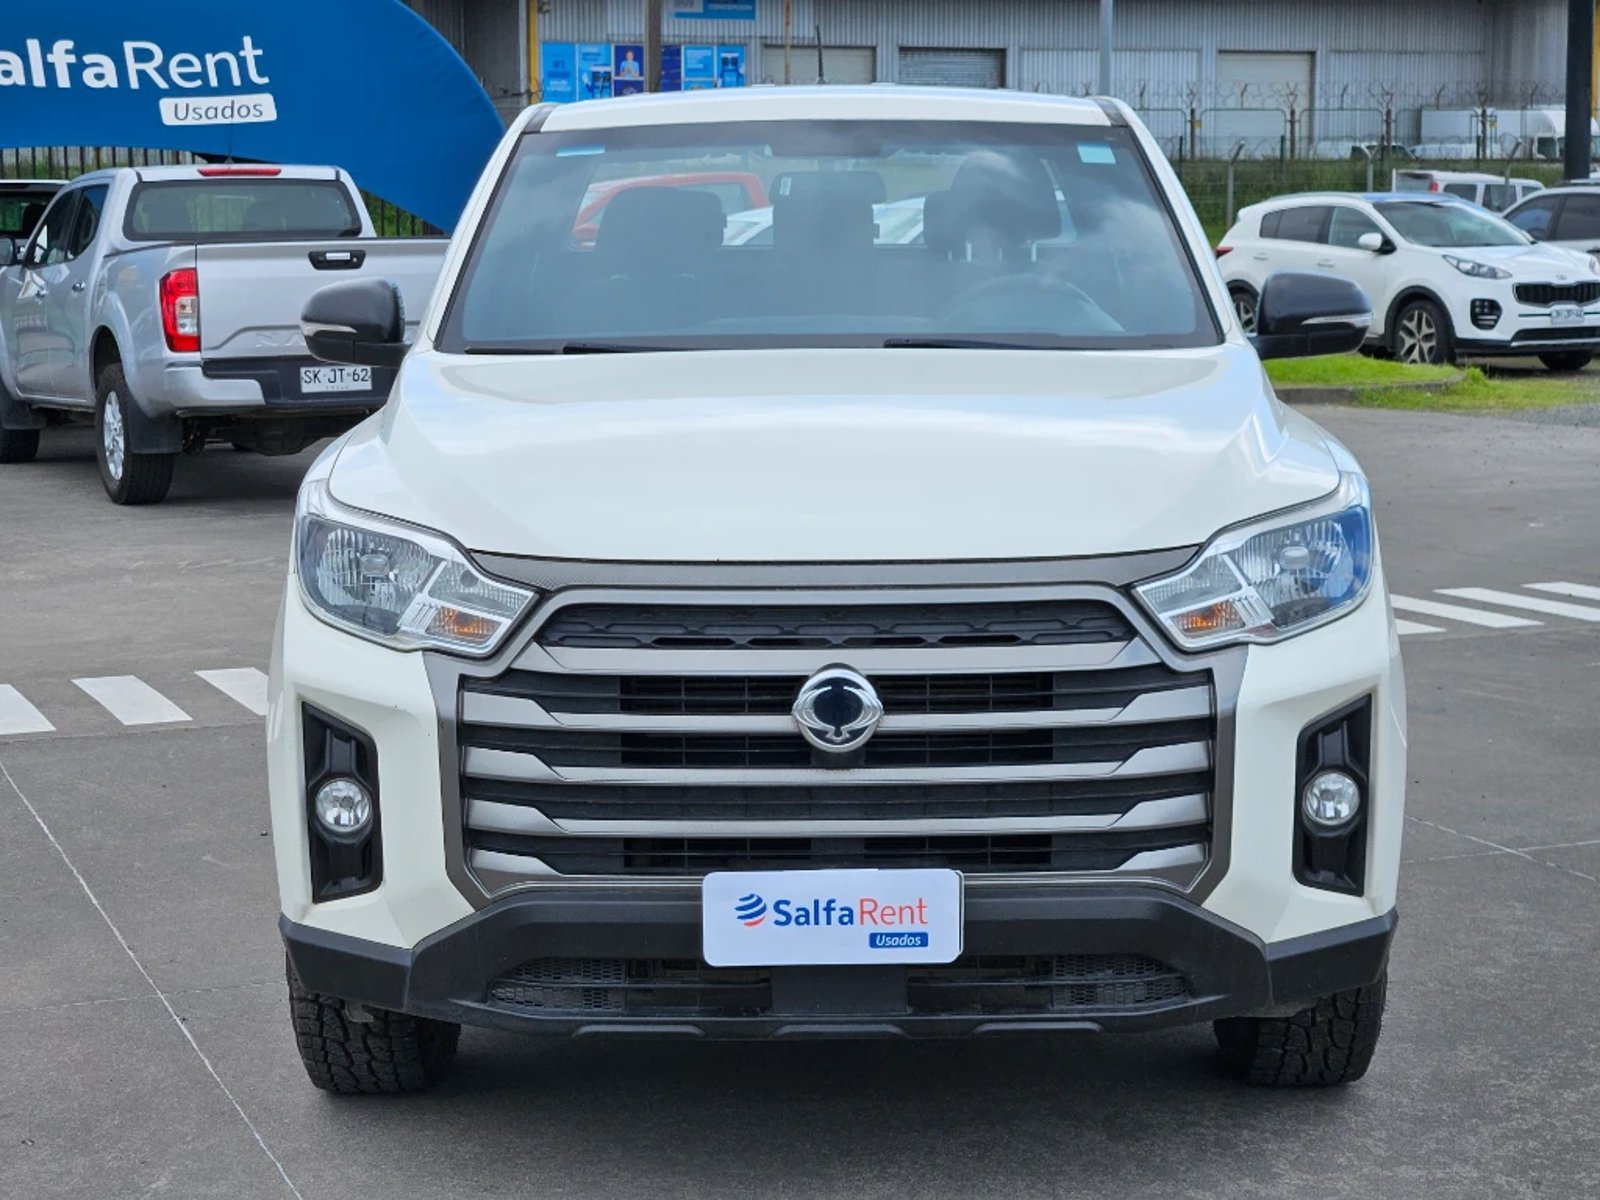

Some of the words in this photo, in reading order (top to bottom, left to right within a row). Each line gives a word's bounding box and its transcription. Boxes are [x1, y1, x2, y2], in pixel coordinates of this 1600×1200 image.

[173, 100, 264, 121] Usados
[773, 898, 928, 927] SalfaRent
[875, 933, 921, 947] Usados
